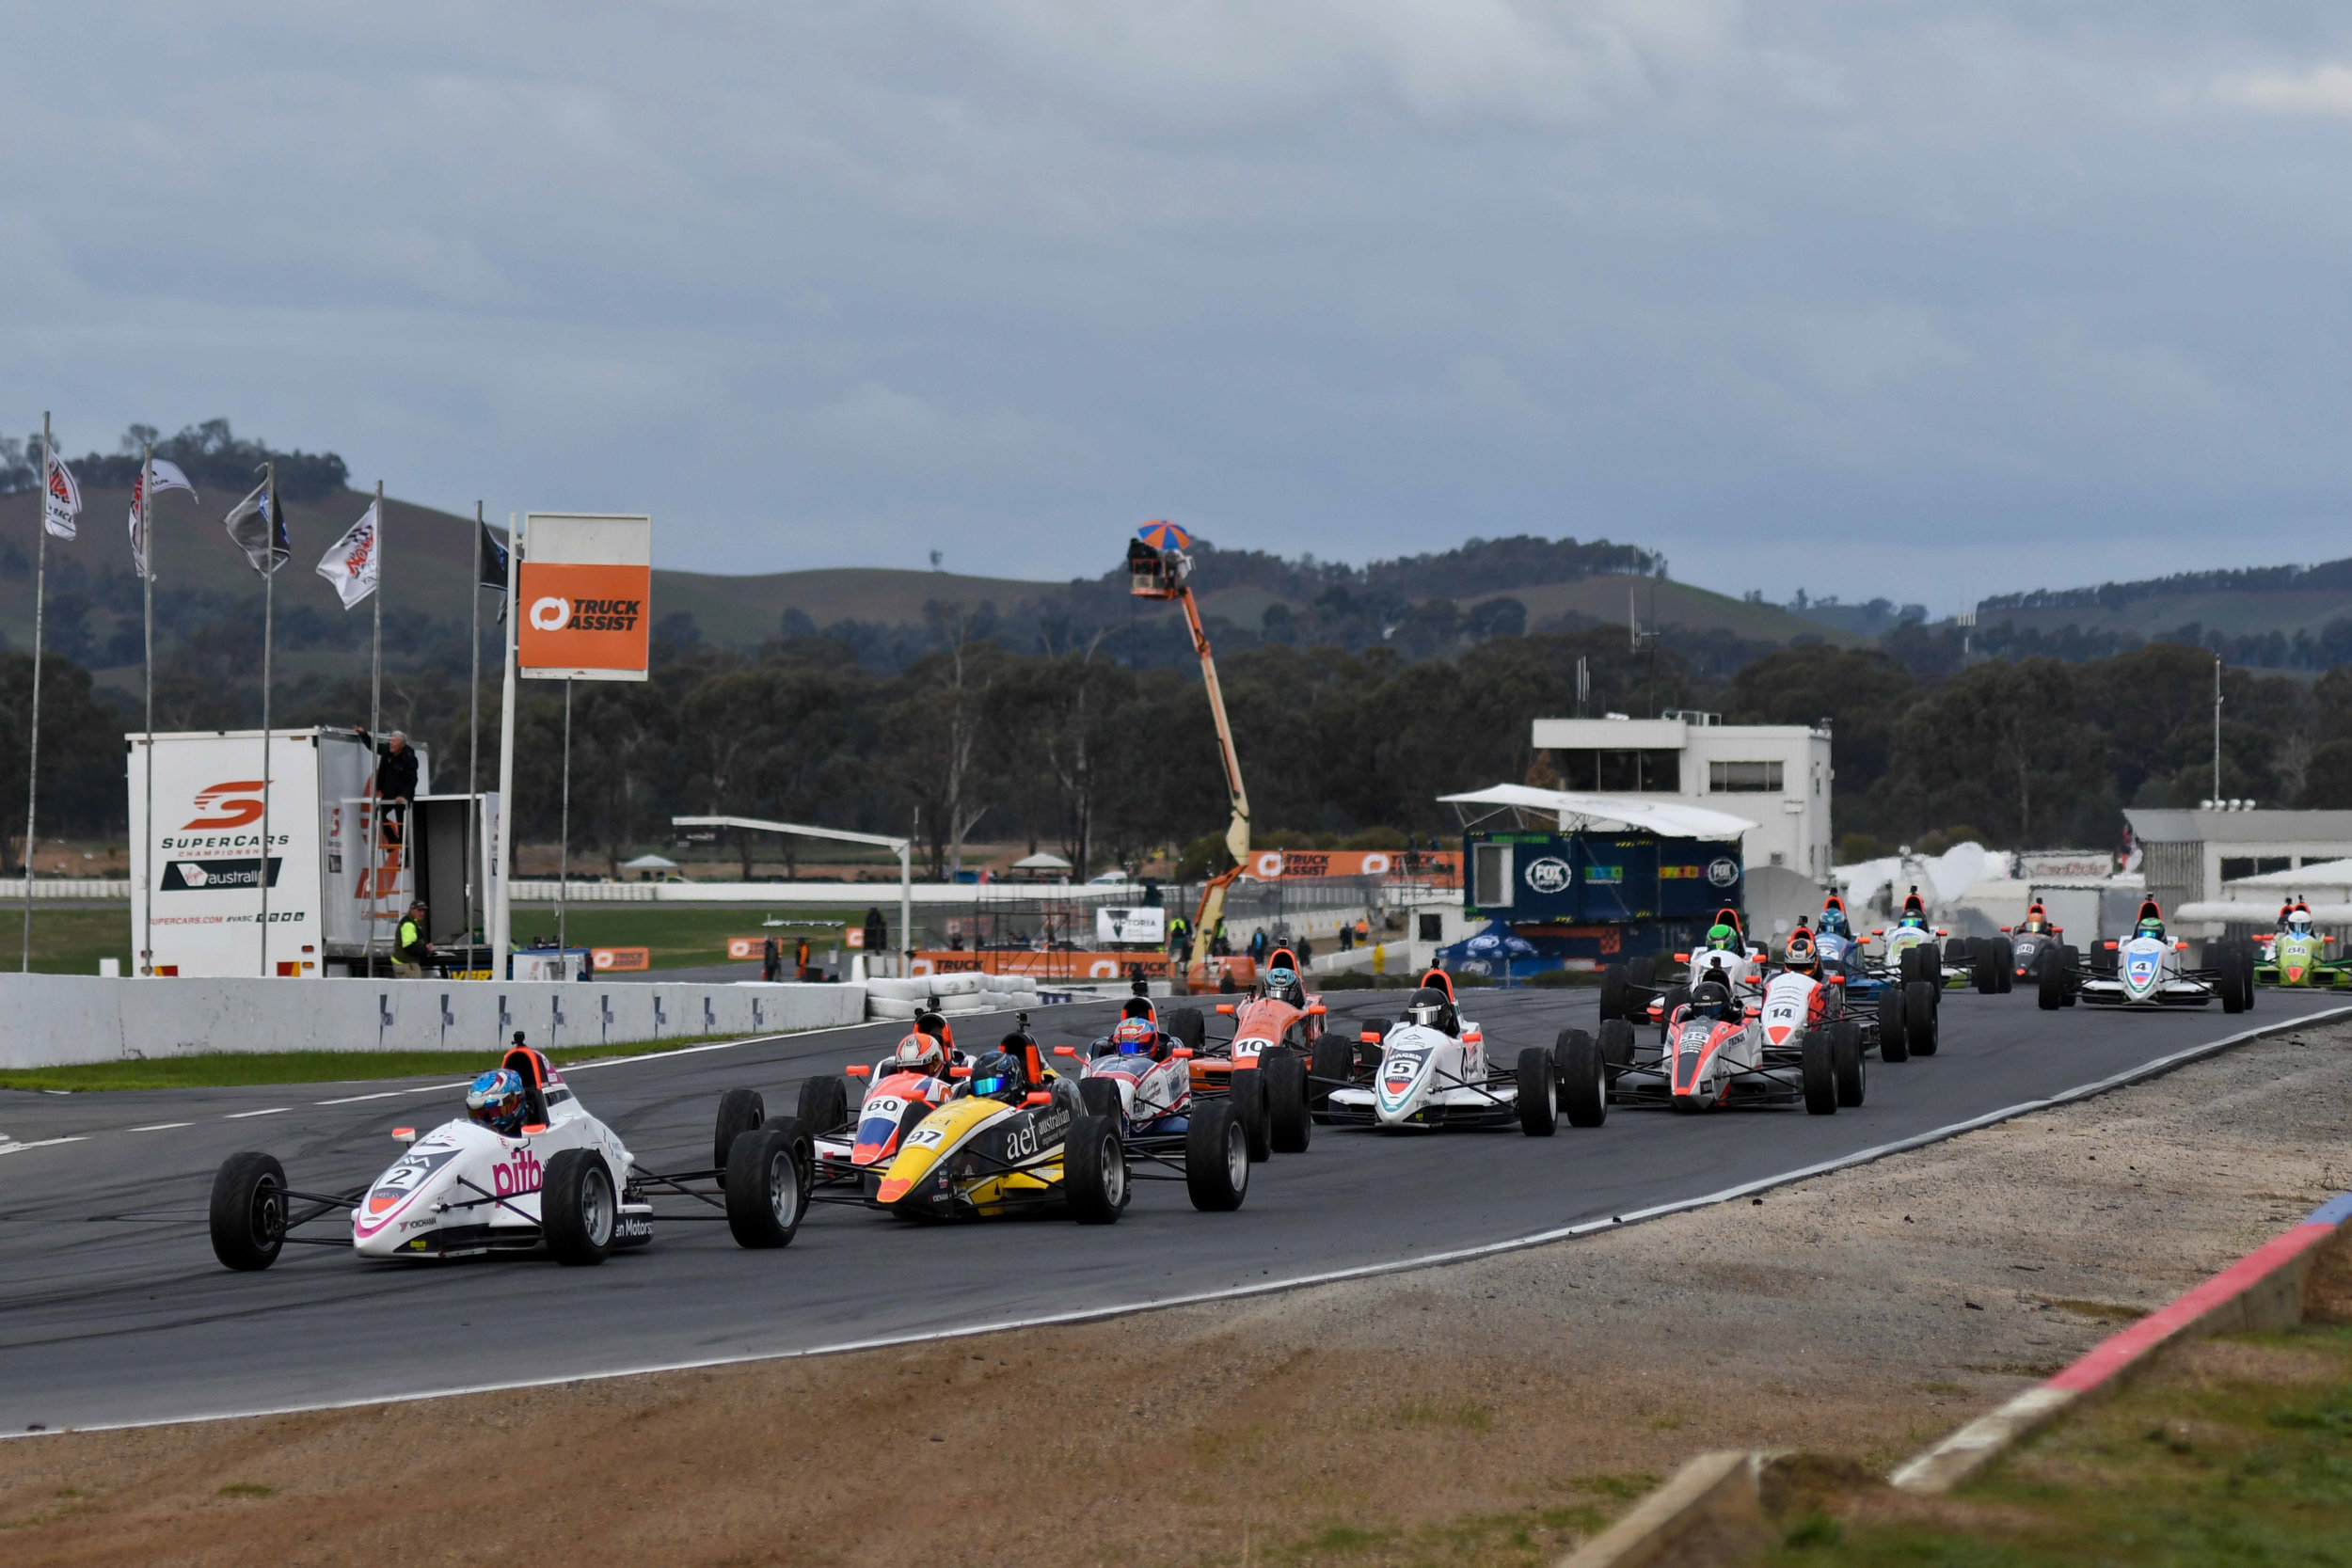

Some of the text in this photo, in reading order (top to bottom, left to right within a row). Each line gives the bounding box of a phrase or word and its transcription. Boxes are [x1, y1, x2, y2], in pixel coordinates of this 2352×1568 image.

[573, 599, 642, 615] TRUCK
[566, 615, 638, 631] ASSIST
[161, 834, 290, 849] SUPERCARS
[1285, 854, 1329, 864] TRUCK
[208, 868, 264, 884] australi
[1282, 865, 1327, 876] ASSIST
[1535, 864, 1563, 881] FOX
[935, 960, 984, 972] TRUCK
[2135, 962, 2146, 971] 4
[1771, 1007, 1793, 1019] 14
[1237, 1040, 1267, 1053] 10
[1391, 1062, 1411, 1074] 5
[866, 1100, 899, 1112] 60
[1038, 1107, 1071, 1135] australian
[906, 1131, 942, 1145] 97
[1007, 1113, 1040, 1161] aef
[386, 1168, 412, 1185] 2
[409, 1216, 437, 1229] YOKOHAMA
